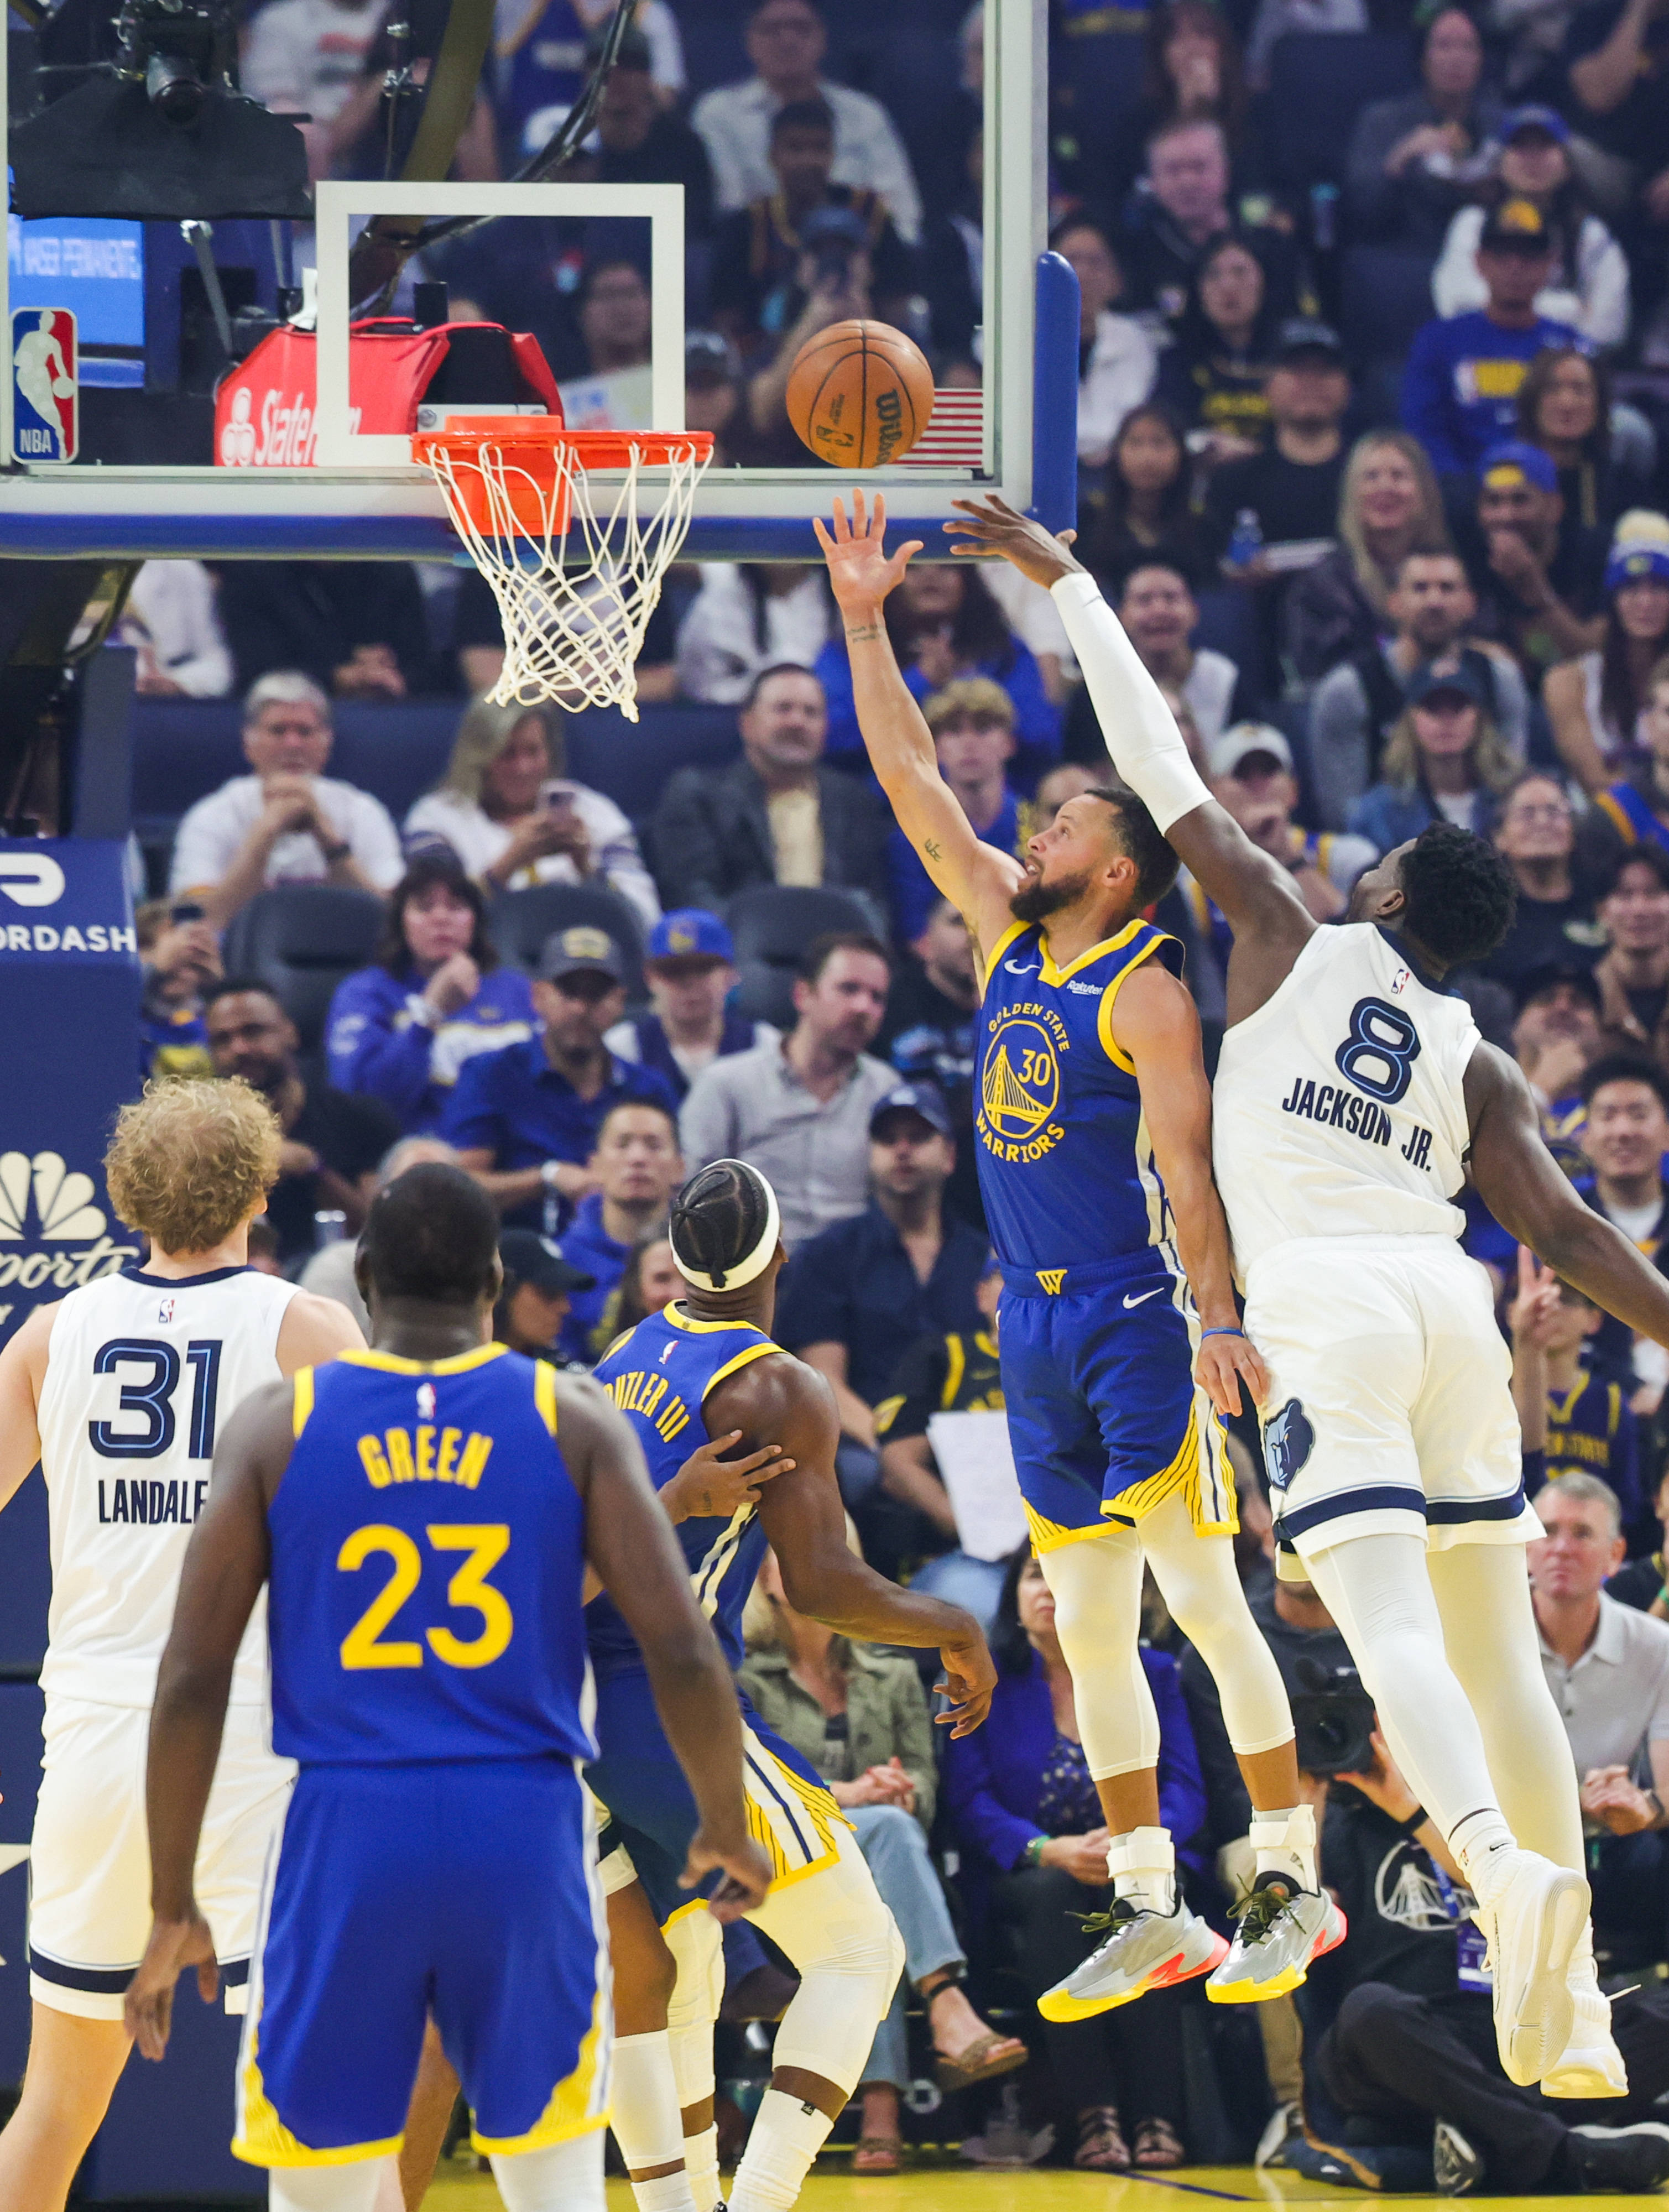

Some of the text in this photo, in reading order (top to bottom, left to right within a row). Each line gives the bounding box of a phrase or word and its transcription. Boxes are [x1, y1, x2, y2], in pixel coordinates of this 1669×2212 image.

[20, 429, 53, 453] NBA
[1067, 980, 1104, 995] Rakuten
[988, 1002, 1071, 1052] GOLDEN STATE
[1335, 997, 1422, 1105] 8
[1018, 1048, 1051, 1087] 30
[975, 1108, 1066, 1164] WARRIORS
[1282, 1078, 1433, 1172] JACKSON JR.
[88, 1338, 223, 1459] 31
[655, 1395, 690, 1443] III
[357, 1425, 494, 1490] GREEN
[336, 1523, 514, 1670] 23
